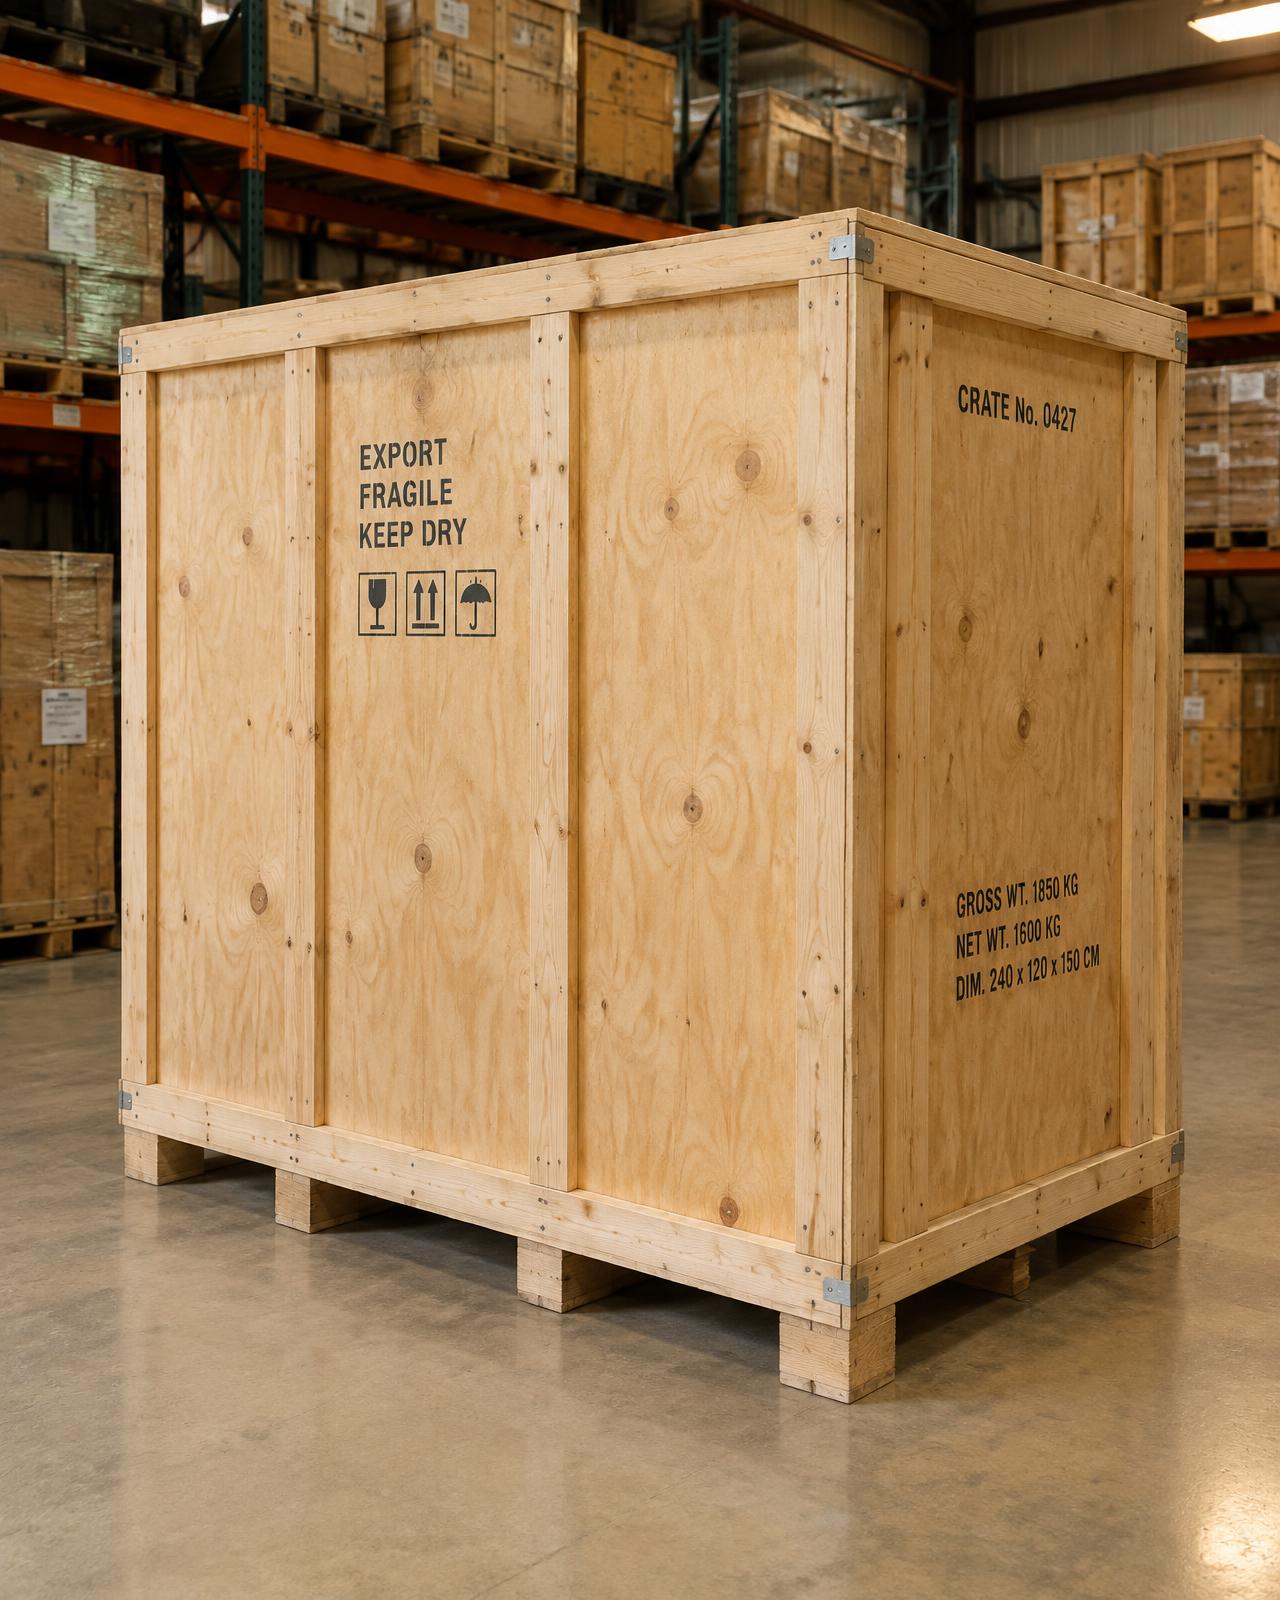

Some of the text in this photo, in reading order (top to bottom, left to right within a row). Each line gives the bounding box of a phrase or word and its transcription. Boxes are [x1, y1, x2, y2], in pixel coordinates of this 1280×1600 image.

[958, 384, 1077, 433] CRATE No. 0427
[360, 438, 447, 471] EXPORT
[360, 478, 453, 510] FRAGILE
[359, 518, 467, 548] KEEP DRY
[956, 872, 1079, 918] GROSS WT. 1850 KG
[956, 914, 1061, 959] NET WT. 1600 KG
[956, 943, 1100, 1001] DIM. 240 x 120 x 150 CM
